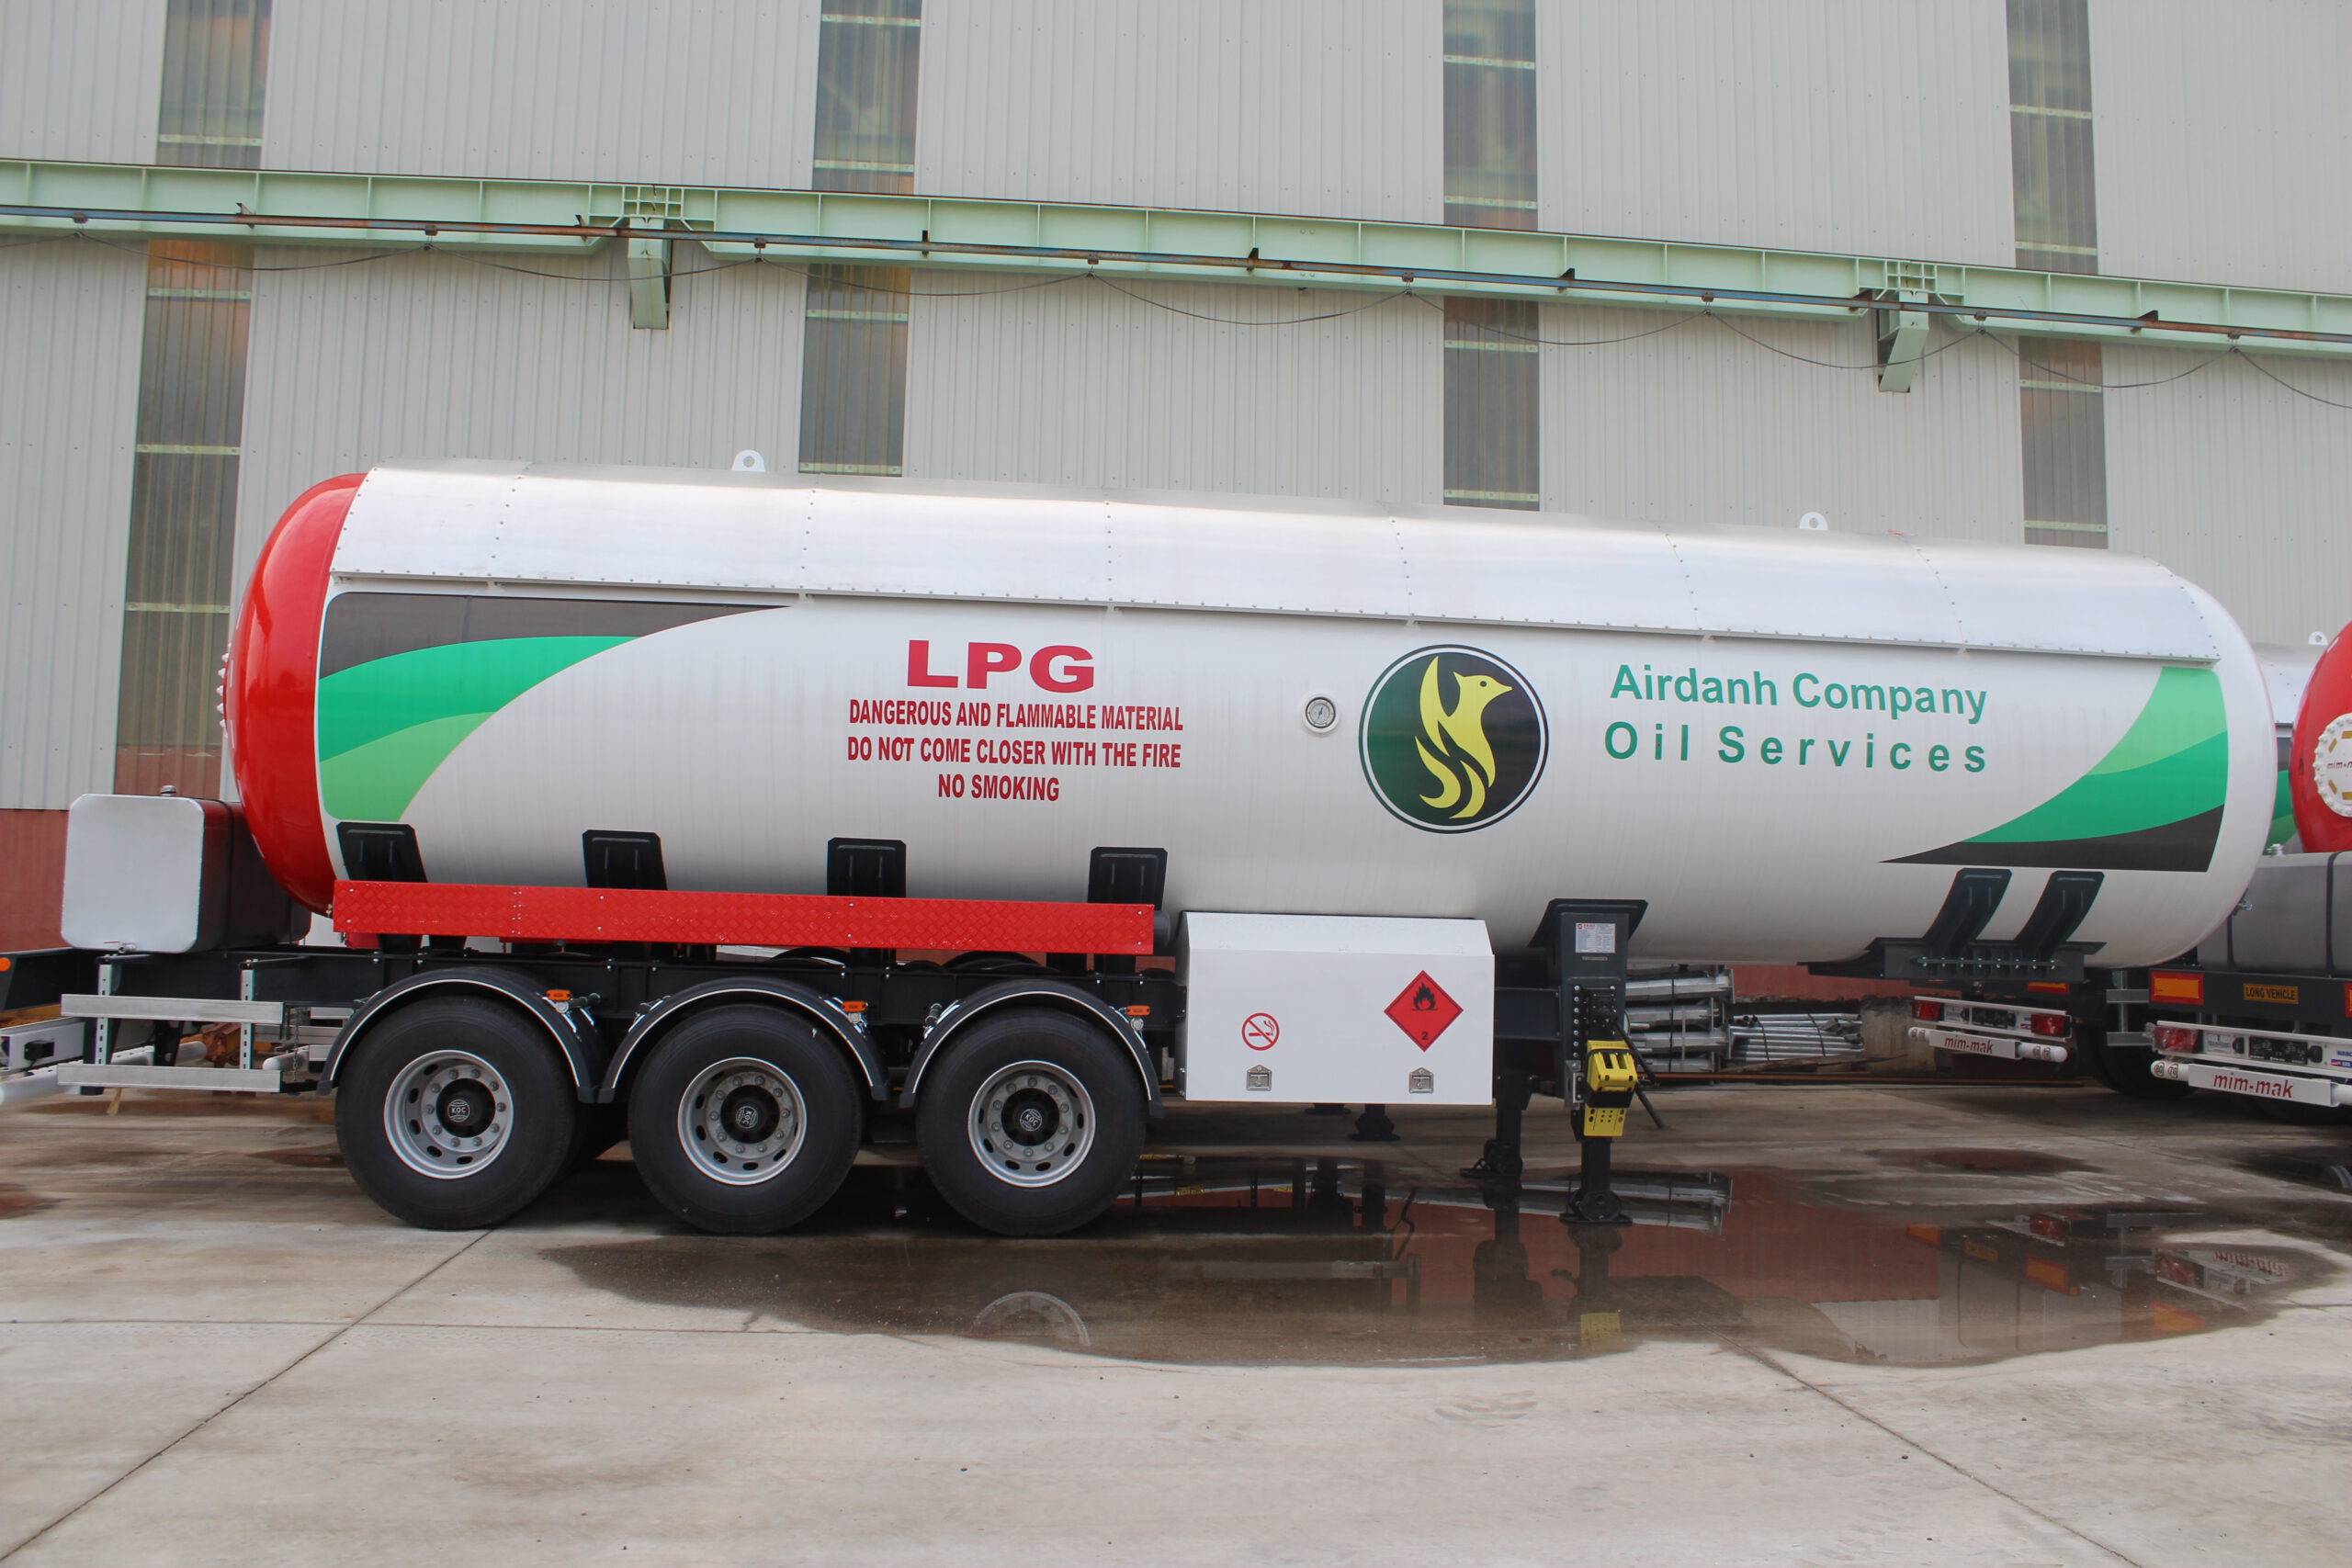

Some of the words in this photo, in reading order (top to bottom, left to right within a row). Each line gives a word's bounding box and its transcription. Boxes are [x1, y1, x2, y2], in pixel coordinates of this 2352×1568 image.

[907, 639, 1095, 693] LPG
[1611, 663, 1779, 705] Airdanh
[1792, 671, 1988, 724] Company
[850, 699, 952, 727] DANGEROUS
[956, 702, 992, 728] AND
[997, 703, 1096, 729] FLAMMABLE
[1102, 705, 1184, 731] MATERIAL
[848, 736, 873, 761] DO
[878, 737, 915, 761] NOT
[921, 738, 971, 762] COME
[977, 739, 1046, 765] CLOSER
[1051, 741, 1097, 766] WITH
[1102, 742, 1137, 767] THE
[1143, 743, 1182, 768] FIRE
[1605, 721, 1690, 761] Oil
[1719, 725, 1987, 773] Services
[938, 773, 966, 798] NO
[971, 774, 1060, 801] SMOKING
[2245, 987, 2265, 998] LONG
[2267, 987, 2296, 1000] VEHICLE
[1421, 1031, 1429, 1040] 2
[1944, 1035, 1994, 1055] mim-mak
[2213, 1073, 2293, 1098] mim-mak
